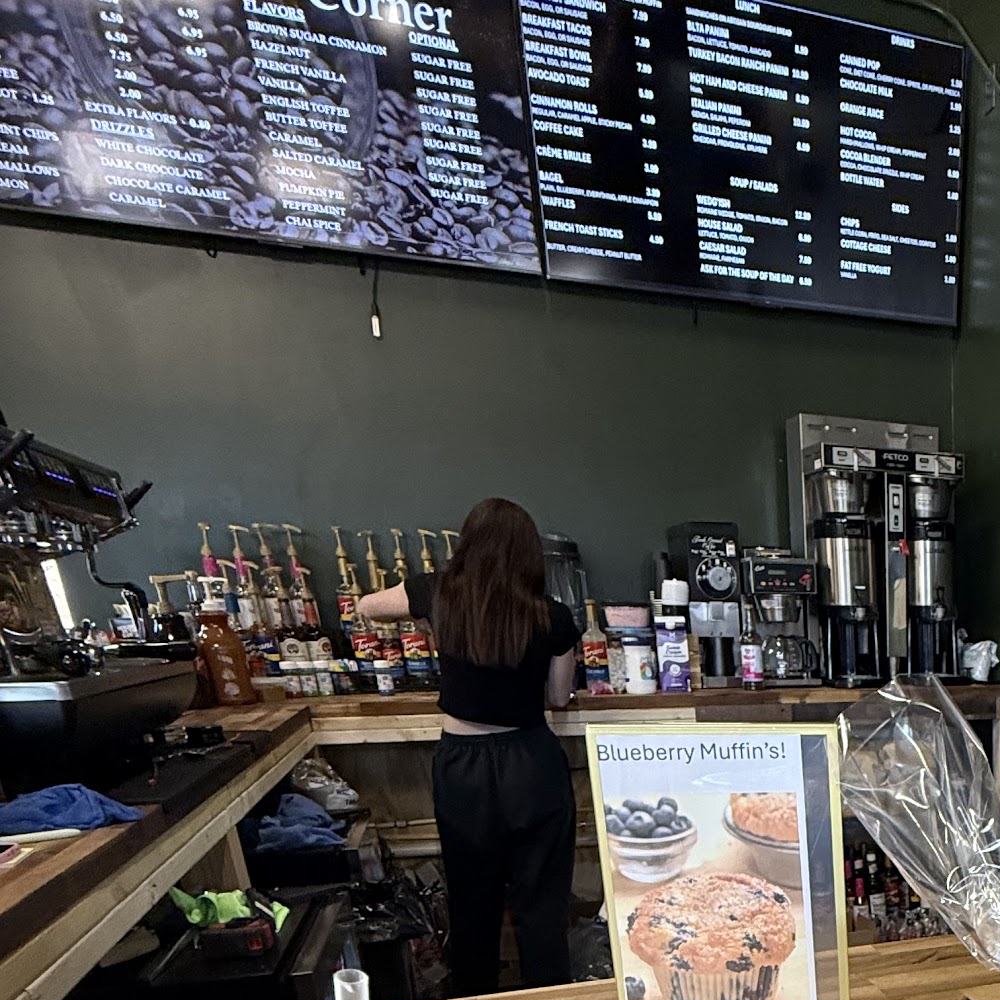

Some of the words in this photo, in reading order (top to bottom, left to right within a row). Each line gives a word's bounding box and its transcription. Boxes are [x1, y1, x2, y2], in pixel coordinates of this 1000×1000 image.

[178, 7, 199, 20] 6.95
[242, 0, 305, 23] FLAVORS
[735, 0, 760, 14] LUNCH
[100, 11, 123, 24] 6.50
[309, 0, 452, 35] orner
[522, 12, 565, 31] BREAKFAST
[566, 21, 592, 36] TACOS
[105, 31, 128, 44] 6.50
[182, 26, 203, 39] 6.95
[246, 19, 288, 38] BROWN
[289, 28, 328, 45] SUGAR
[328, 36, 387, 56] CINNAMON
[705, 24, 729, 38] PANINI
[249, 38, 311, 58] HAZELNUT
[408, 31, 459, 52] OPTIONAL
[891, 34, 915, 49] DRINKS
[186, 46, 207, 58] 6.95
[525, 39, 568, 58] BREAKFAST
[569, 49, 592, 62] BOWL
[410, 53, 447, 67] SUGAR
[447, 59, 473, 73] FREE
[688, 46, 716, 62] TURKEY
[716, 53, 741, 66] BACON
[742, 58, 765, 72] RANCH
[766, 62, 789, 76] PANINI
[840, 53, 866, 68] CANNED
[867, 59, 881, 70] POP
[115, 69, 137, 82] 2.00
[253, 57, 300, 74] FRENCH
[299, 66, 347, 83] VANILLA
[528, 67, 565, 84] AVOCADO
[566, 74, 590, 88] TOAST
[258, 76, 306, 93] VANILLA
[413, 70, 449, 85] SUGAR
[449, 76, 475, 89] FREE
[689, 72, 706, 84] HOT
[706, 75, 721, 88] HAM
[722, 78, 737, 90] AND
[738, 82, 764, 96] CHEESE
[765, 86, 788, 101] PANINI
[840, 78, 877, 95] CHOCOLATE
[878, 87, 893, 98] MILK
[32, 93, 54, 105] 1.25
[119, 88, 141, 100] 2.00
[416, 87, 451, 102] SUGAR
[451, 94, 477, 106] FREE
[261, 94, 309, 111] ENGLISH
[309, 102, 350, 117] TOFFEE
[531, 93, 573, 110] CINNAMON
[574, 101, 598, 114] ROLLS
[691, 97, 718, 112] ITALIAN
[718, 102, 742, 116] PANINI
[840, 102, 866, 116] ORANGE
[867, 108, 884, 119] JUICE
[84, 101, 126, 118] EXTRA
[128, 109, 177, 125] FLAVORS
[418, 105, 453, 118] SUGAR
[454, 111, 479, 123] FREE
[91, 119, 155, 140] DRIZZLES
[264, 112, 307, 127] BUTTER
[308, 119, 348, 133] TOFFEE
[421, 122, 455, 135] SUGAR
[455, 127, 481, 139] FREE
[533, 120, 563, 134] COFFEE
[564, 126, 584, 137] CAKE
[22, 128, 59, 142] CHIPS
[268, 131, 322, 147] CARAMEL
[692, 122, 721, 136] GRILLED
[722, 127, 748, 141] CHEESE
[749, 132, 772, 146] PANINI
[840, 125, 854, 136] HOT
[854, 128, 877, 141] COCOA
[95, 138, 134, 153] WHITE
[136, 142, 205, 163] CHOCOLATE
[423, 138, 457, 152] SUGAR
[458, 145, 482, 155] FREE
[272, 148, 312, 162] SALTED
[314, 156, 365, 170] CARAMEL
[426, 156, 460, 169] SUGAR
[460, 161, 485, 173] FREE
[563, 149, 592, 164] BRULEE
[840, 149, 863, 161] COCOA
[864, 153, 891, 166] BLENDER
[100, 157, 134, 170] DARK
[137, 161, 204, 180] CHOCOLATE
[274, 165, 316, 179] MOCHA
[539, 170, 564, 183] BAGEL
[105, 176, 174, 193] CHOCOLATE
[176, 185, 230, 200] CARAMEL
[428, 172, 462, 186] SUGAR
[462, 178, 487, 189] FREE
[729, 176, 749, 188] SOUP
[753, 180, 778, 193] SALADS
[840, 172, 863, 185] BOTTLE
[864, 176, 884, 188] WATER
[278, 182, 326, 198] PUMPKIN
[328, 190, 345, 200] PIE
[430, 189, 464, 202] SUGAR
[465, 195, 489, 205] FREE
[109, 192, 166, 208] CARAMEL
[282, 199, 346, 216] PEPPERMINT
[542, 196, 576, 209] WAFFLES
[891, 203, 910, 214] SIDES
[286, 216, 312, 227] CHAI
[313, 220, 341, 231] SPICE
[544, 220, 574, 233] FRENCH
[575, 224, 598, 236] TOAST
[598, 227, 624, 239] STICKS
[697, 218, 721, 230] HOUSE
[722, 221, 743, 233] SALAD
[840, 216, 860, 228] CHIPS
[699, 241, 725, 254] CAESAR
[725, 245, 746, 256] SALAD
[840, 239, 868, 252] COTTAGE
[868, 243, 892, 255] CHEESE
[700, 263, 713, 273] ASK
[714, 265, 728, 275] FOR
[728, 267, 741, 277] THE
[741, 269, 759, 279] SOUP
[759, 271, 769, 280] OF
[769, 272, 781, 283] THE
[781, 274, 794, 284] DAY
[840, 260, 852, 270] FAT
[852, 262, 867, 272] FREE
[868, 264, 891, 275] YOGURT
[596, 744, 694, 764] Blueberry
